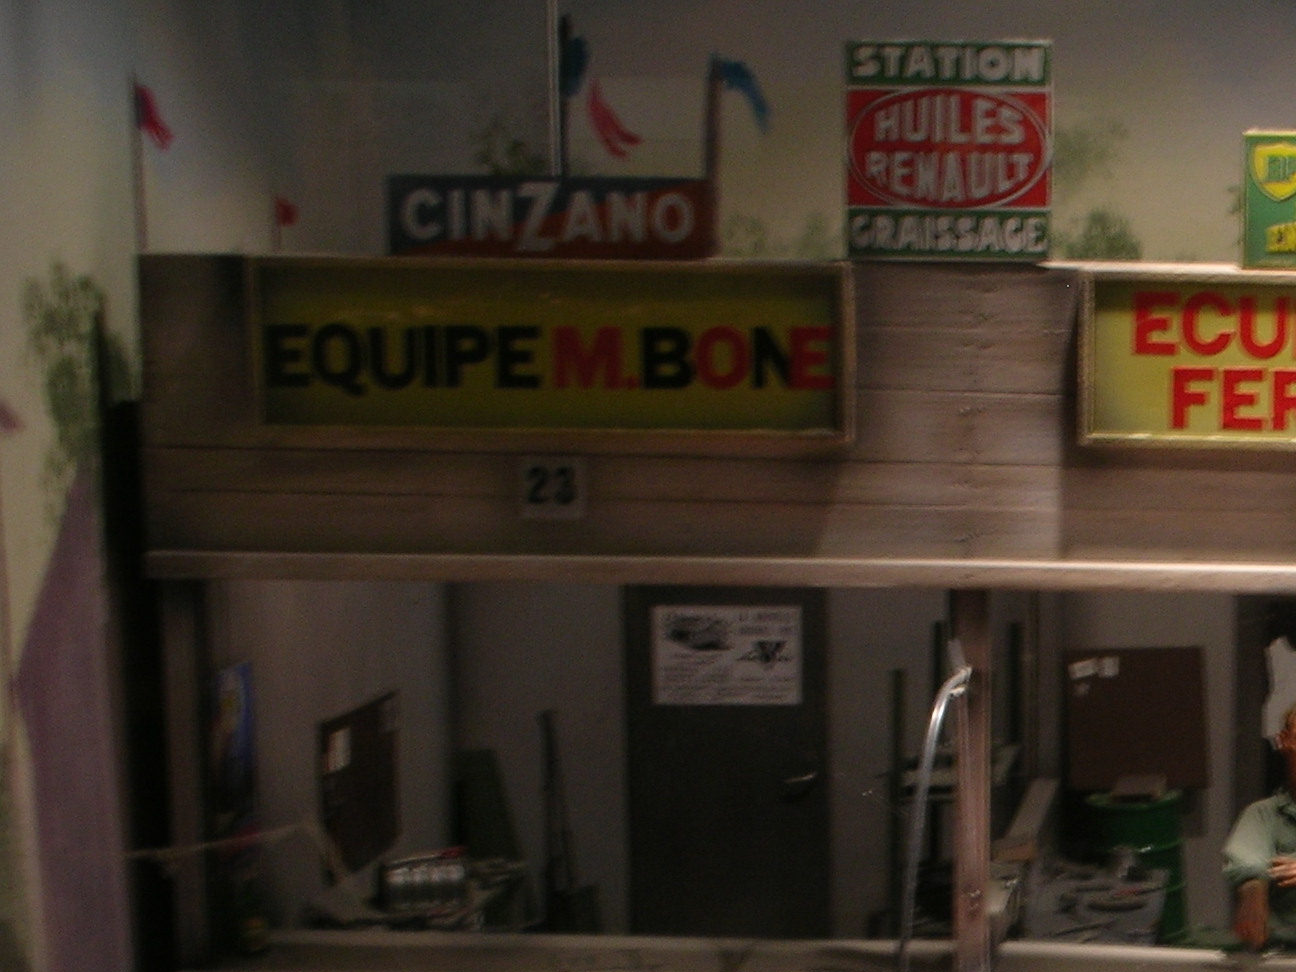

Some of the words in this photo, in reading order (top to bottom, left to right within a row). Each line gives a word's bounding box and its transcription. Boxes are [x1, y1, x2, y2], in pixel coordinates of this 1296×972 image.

[852, 46, 1044, 81] STATION
[873, 93, 1025, 144] HUILES
[865, 150, 1034, 202] RENAULT
[404, 181, 695, 250] CINZANO
[852, 214, 1048, 253] GRAISSAGE
[263, 324, 540, 395] EQUIPE
[525, 466, 577, 505] 23
